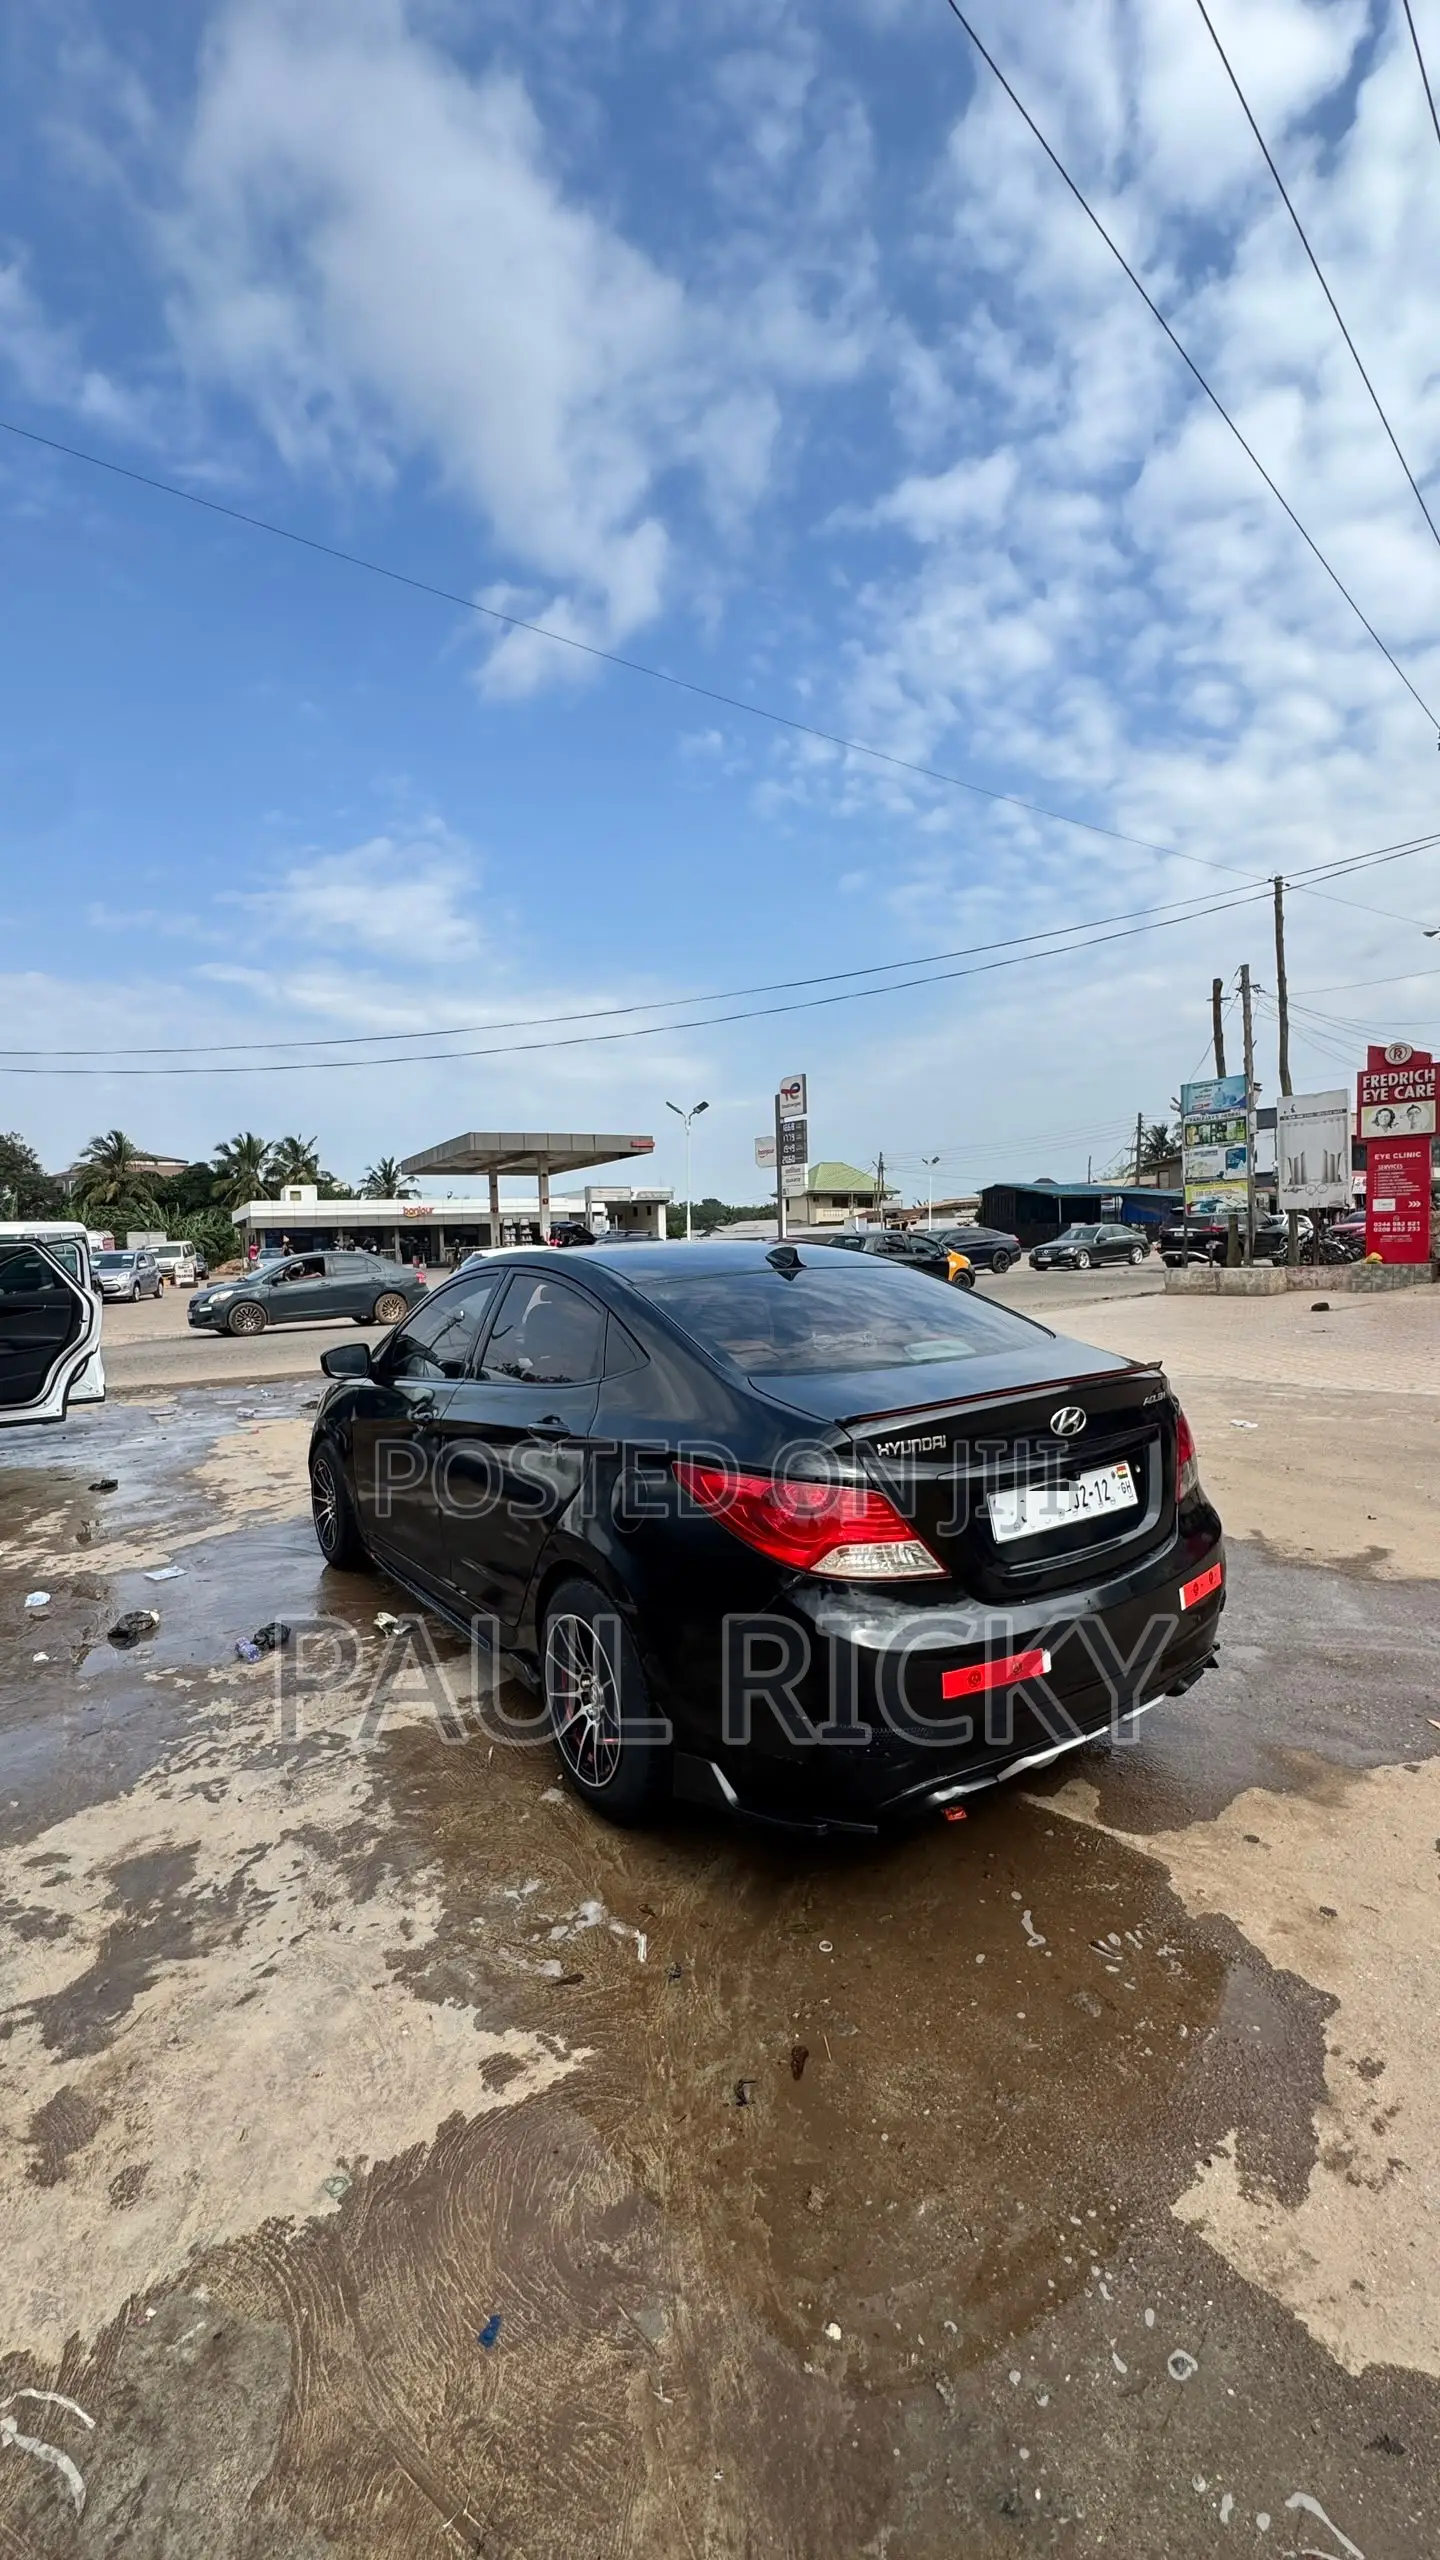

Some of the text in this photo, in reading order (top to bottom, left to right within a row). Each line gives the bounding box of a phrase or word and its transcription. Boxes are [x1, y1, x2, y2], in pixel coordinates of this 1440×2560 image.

[1362, 1069, 1436, 1089] FREDRICH
[1362, 1083, 1436, 1103] EYE CARE
[1374, 1151, 1422, 1161] EYE CLINIC
[876, 1434, 947, 1457] HYUNDAI
